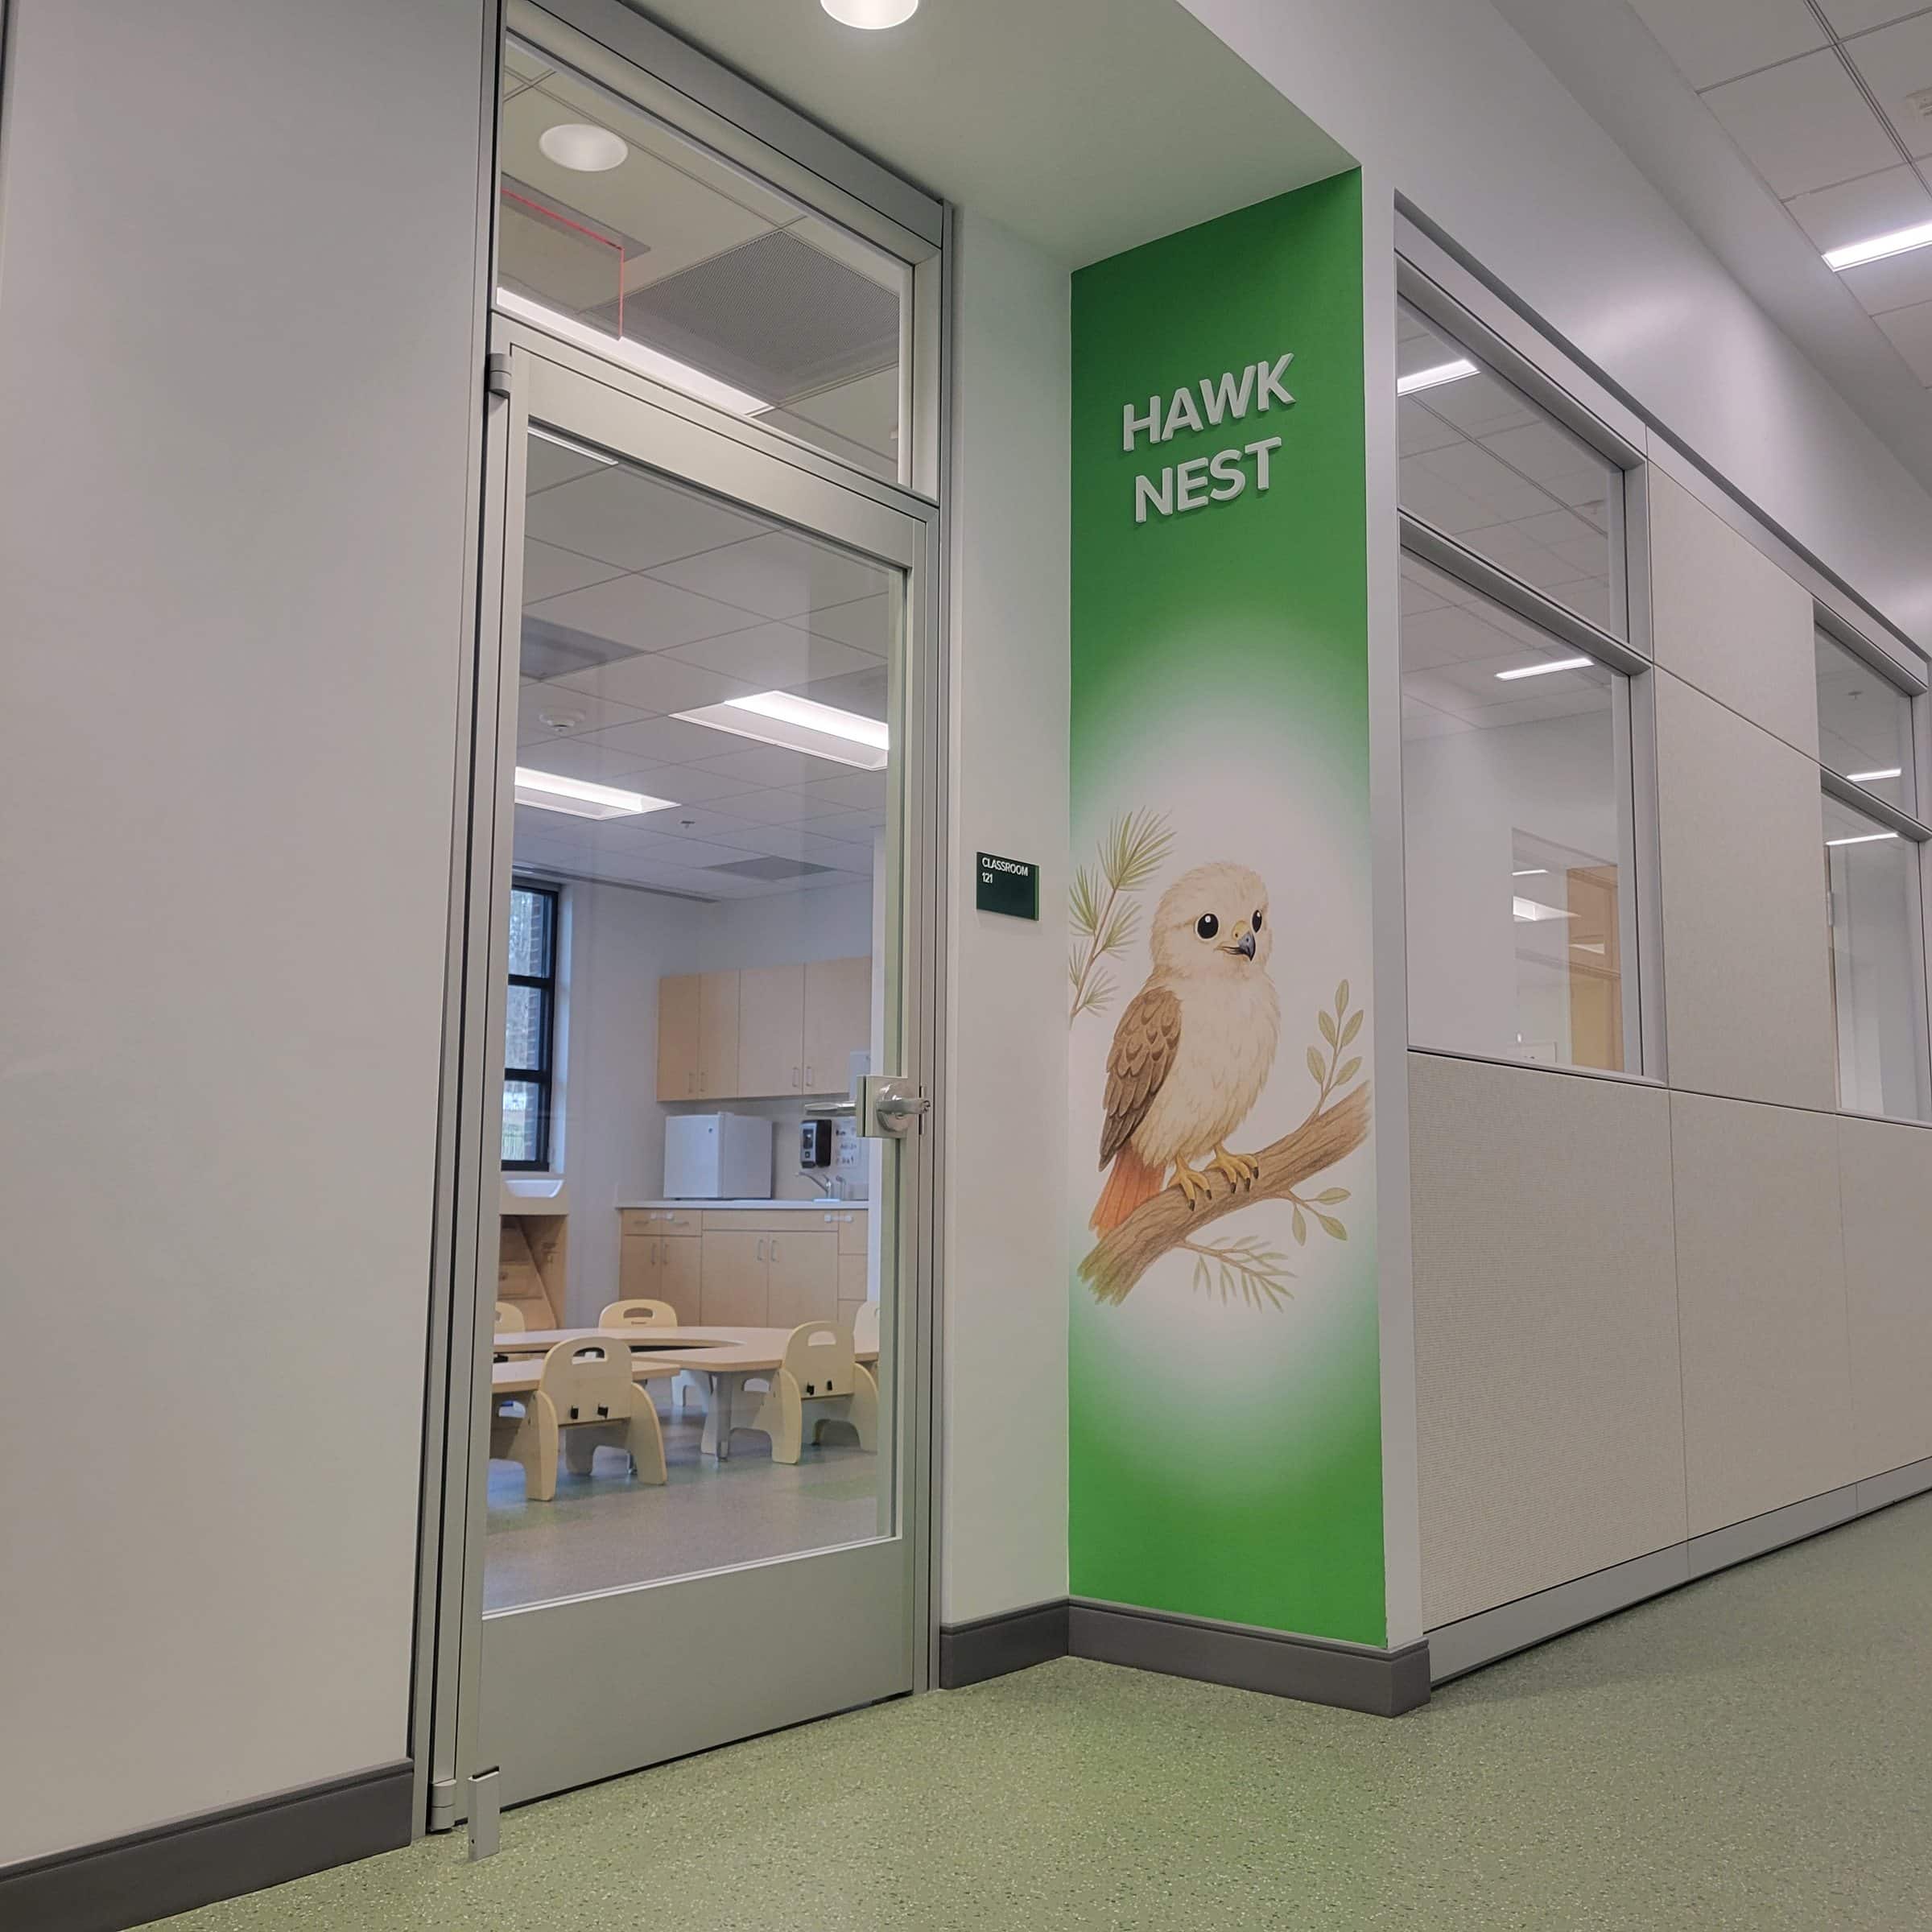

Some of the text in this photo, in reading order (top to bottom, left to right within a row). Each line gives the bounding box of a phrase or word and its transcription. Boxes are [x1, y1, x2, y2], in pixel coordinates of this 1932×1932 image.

[1123, 353, 1296, 452] HAWK
[1135, 436, 1282, 523] NEST
[982, 857, 1029, 876] CLASSROOM
[982, 872, 993, 883] 121
